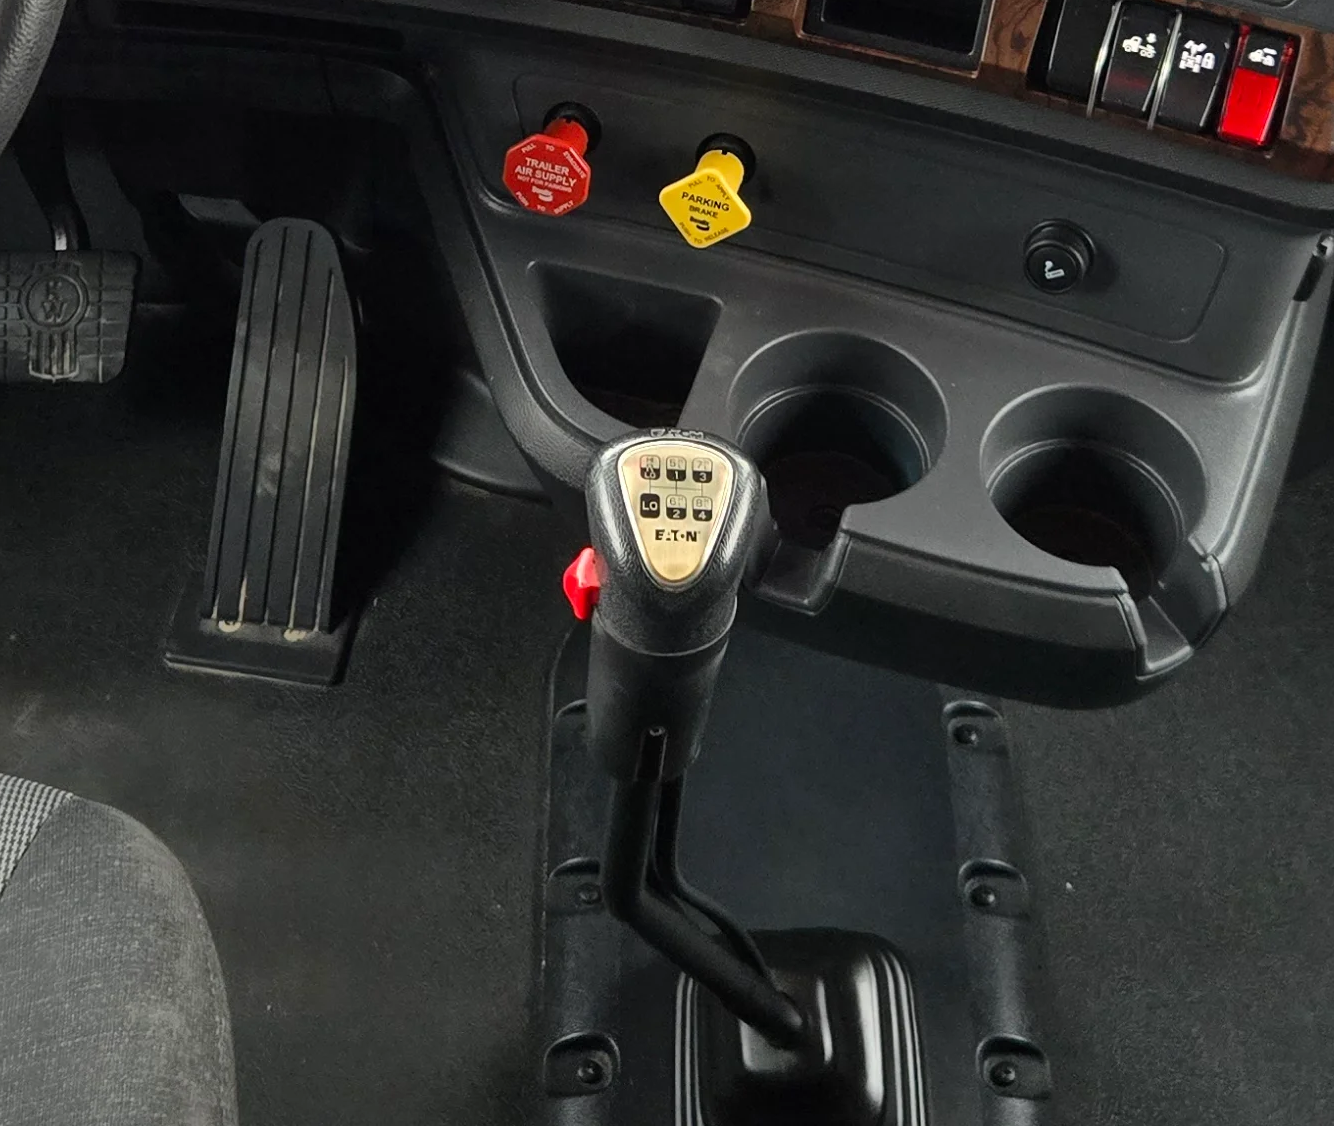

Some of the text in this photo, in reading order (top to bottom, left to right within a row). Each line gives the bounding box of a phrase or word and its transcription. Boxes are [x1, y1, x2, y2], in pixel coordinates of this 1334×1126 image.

[521, 143, 536, 153] PULL
[545, 144, 555, 152] TO
[525, 157, 569, 176] TRAILER
[515, 165, 577, 187] AIR SUPPLY
[530, 178, 544, 186] FOR
[544, 181, 572, 193] PARKING
[688, 179, 703, 189] PULL
[715, 184, 730, 201] APPLY
[516, 191, 529, 206] PUSH
[537, 204, 546, 212] TO
[682, 191, 730, 212] PARKING
[689, 205, 718, 219] BRAKE
[704, 227, 729, 242] RELEASE
[699, 473, 707, 482] 3
[642, 501, 658, 511] LO
[672, 510, 680, 519] 2
[698, 511, 707, 520] 4
